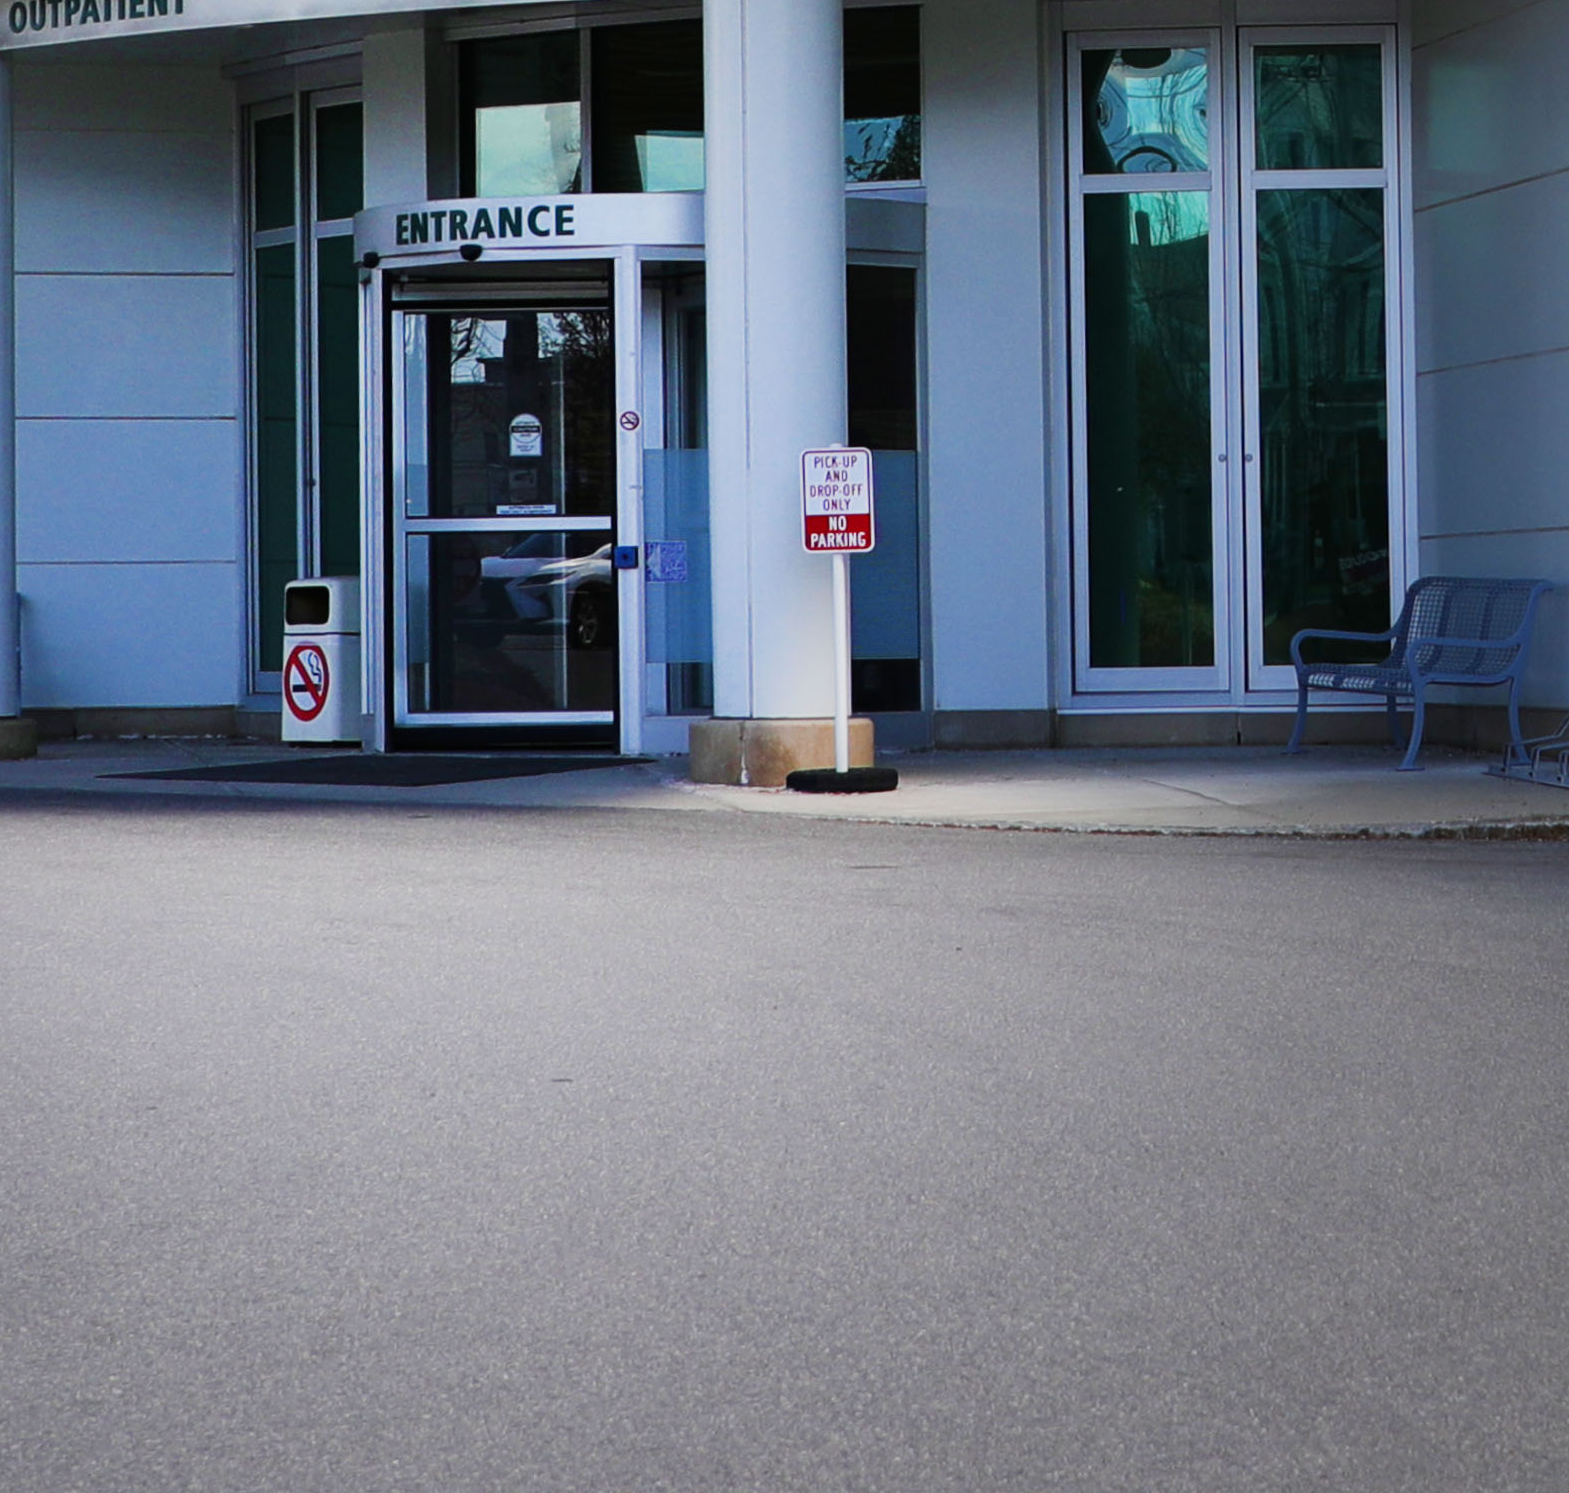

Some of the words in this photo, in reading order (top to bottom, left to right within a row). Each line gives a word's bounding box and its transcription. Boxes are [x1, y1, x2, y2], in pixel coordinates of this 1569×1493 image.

[396, 204, 575, 246] ENTRANCE
[814, 455, 858, 469] PICK-UP
[825, 470, 848, 482] AND
[810, 484, 863, 498] DROP-OFF
[823, 499, 851, 511] ONLY
[829, 515, 847, 531] NO
[810, 531, 866, 548] PARKING
